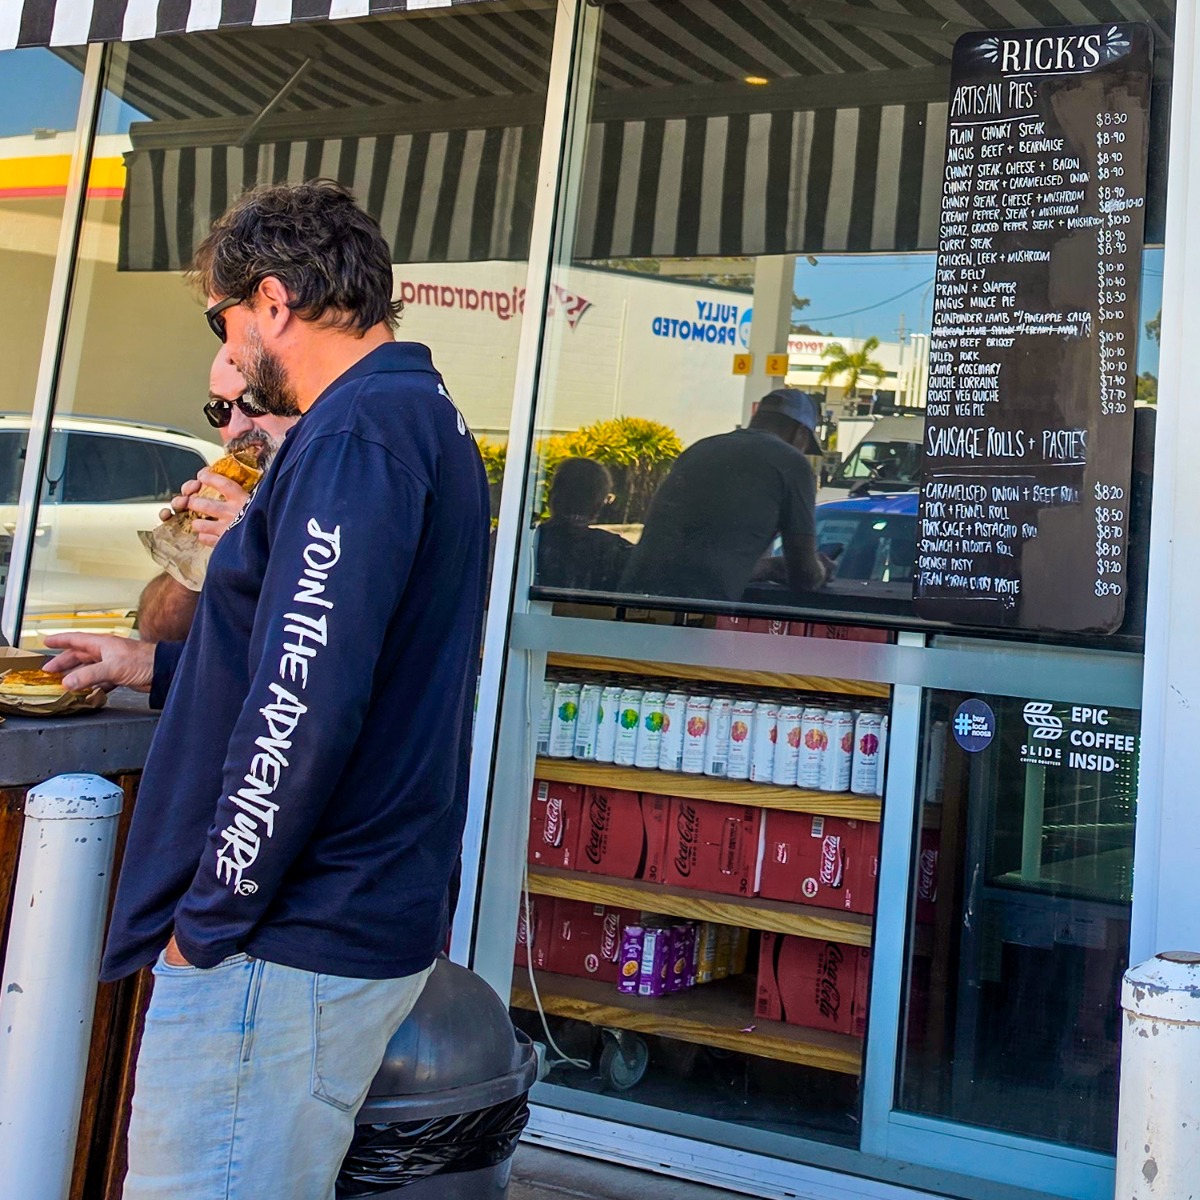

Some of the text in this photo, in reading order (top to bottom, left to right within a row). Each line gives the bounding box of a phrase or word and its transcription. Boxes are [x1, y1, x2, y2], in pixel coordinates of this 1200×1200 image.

[1001, 34, 1101, 72] RICK'S
[950, 82, 1001, 117] ARTISAN
[950, 128, 974, 145] PLAIN
[981, 123, 1011, 141] CHUNKY
[1019, 122, 1045, 137] STEAK
[947, 147, 974, 162] ANGUS
[981, 143, 1004, 158] BEEF
[1019, 138, 1064, 153] BEARNAISE
[945, 164, 973, 180] CHUNKY
[1006, 161, 1036, 175] CHEESE
[1053, 158, 1079, 171] BACON
[944, 180, 972, 194] CHUNKY
[976, 179, 1000, 191] STEAK
[1010, 175, 1063, 189] CARAMELISED
[942, 195, 969, 209] CHUNKY
[1002, 193, 1033, 207] CHEESE
[941, 211, 968, 224] CREAMY
[1005, 207, 1029, 220] STEAK
[1039, 205, 1078, 217] MUSHROOM
[971, 222, 999, 234] CRACKED
[1032, 220, 1054, 230] STEAK
[940, 238, 966, 252] CURRY
[970, 237, 993, 250] STEAK
[977, 252, 997, 264] LEEK
[1007, 250, 1050, 262] MUSHROOM
[960, 268, 986, 280] BELLY
[936, 282, 968, 296] PRAWN
[982, 281, 1017, 294] SNAPPER
[935, 297, 964, 311] ANGUS
[970, 296, 997, 308] MINCE
[1002, 295, 1016, 308] PIE
[985, 312, 1010, 324] LAMB
[960, 338, 981, 347] BEEF
[986, 338, 1015, 347] BRISKET
[930, 351, 954, 362] PULLED
[960, 351, 980, 361] PORK
[929, 364, 952, 375] LAMB
[958, 363, 1001, 375] ROSEMARY
[928, 376, 956, 389] QUICHE
[960, 376, 999, 389] LORRAINE
[927, 390, 952, 402] ROAST
[955, 390, 970, 402] VEG
[972, 390, 999, 402] QUICHE
[927, 404, 950, 416] ROAST
[955, 404, 970, 416] VEG
[972, 404, 985, 416] PIE
[926, 425, 1088, 460] SAUSAGE ROLLS PASTIES
[926, 482, 987, 503] CARAMELISED
[992, 485, 1019, 502] ONION
[1033, 485, 1059, 504] BEEF
[925, 502, 946, 518] PORK
[955, 503, 985, 519] FENNEL
[988, 505, 1010, 520] ROLL
[974, 522, 1017, 538] PISTACHIO
[920, 538, 953, 553] SPINACH
[962, 540, 992, 553] RICOTTA
[294, 517, 342, 610] JOIN
[918, 555, 947, 570] CORNISH
[951, 559, 973, 572] PASTY
[994, 579, 1020, 594] PASTIE
[278, 611, 329, 690] THE
[972, 714, 986, 723] buy
[1072, 706, 1109, 725] EPIC
[972, 722, 989, 730] local
[1070, 730, 1135, 753] COFFEE
[1020, 744, 1062, 759] SLIDE
[1069, 752, 1118, 773] INSID
